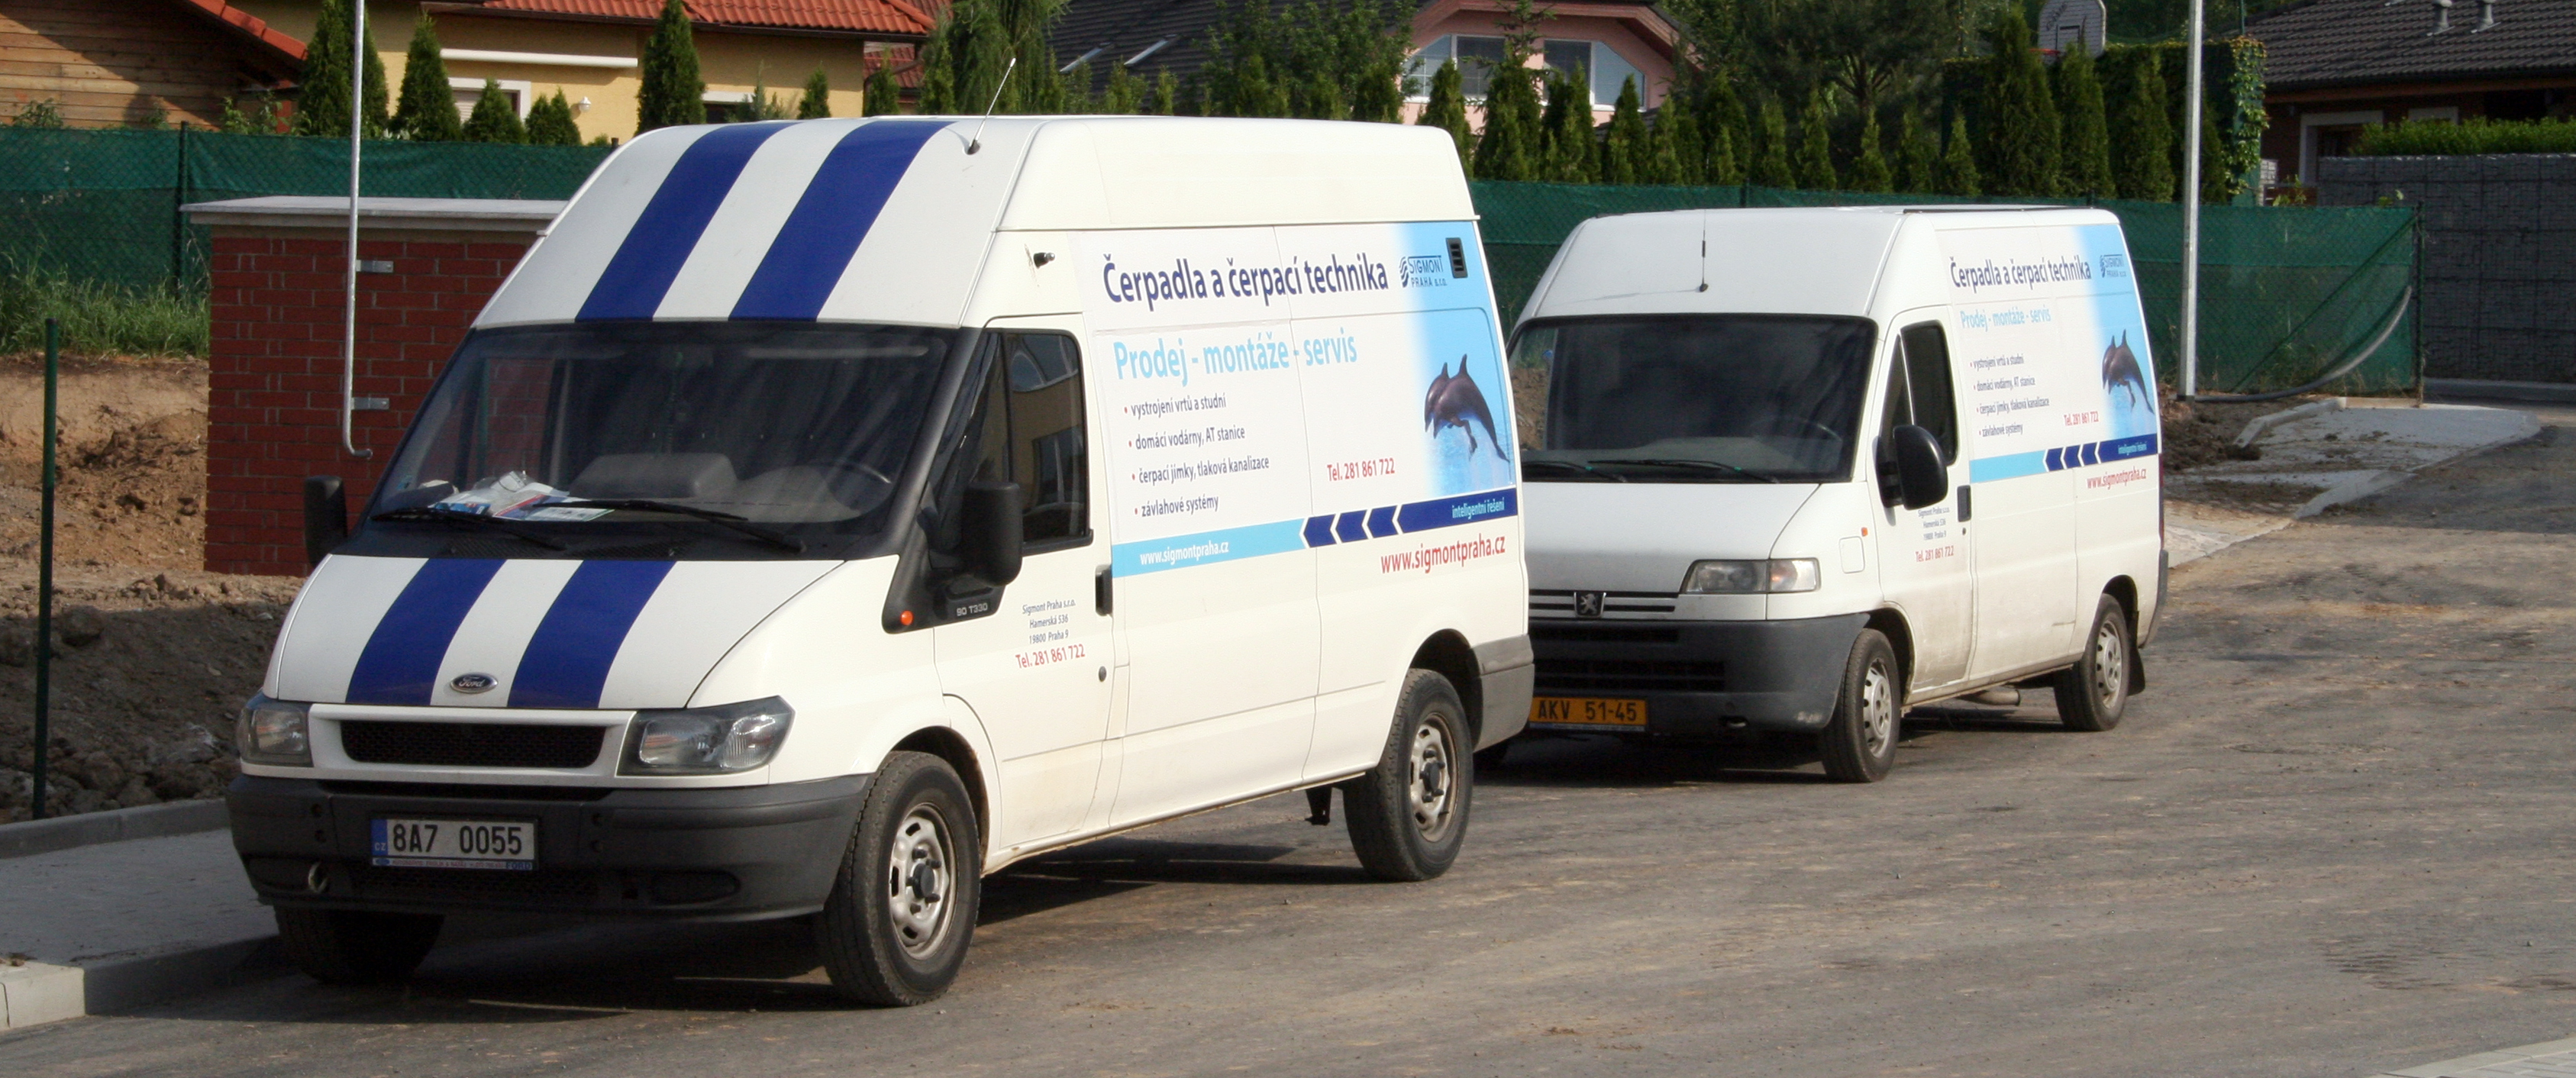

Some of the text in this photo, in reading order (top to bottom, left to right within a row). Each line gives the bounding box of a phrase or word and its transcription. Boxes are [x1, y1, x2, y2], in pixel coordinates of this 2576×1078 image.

[1407, 255, 1444, 274] SIGMONT
[1949, 254, 2092, 293] Čerpadla a čerpací technika
[1103, 252, 1389, 311] Čerpadla a čerpací technika
[1411, 276, 1433, 287] PRAHA
[1960, 309, 1988, 332] Prodej
[1992, 306, 2026, 326] montáže
[2029, 304, 2051, 323] servis
[1113, 337, 1188, 387] Prodej
[1202, 331, 1290, 374] montáže
[1303, 327, 1357, 366] servis
[1131, 392, 1227, 420] vystrojení vrtů a studní
[2064, 413, 2073, 426] Tel.
[2090, 411, 2100, 423] 722
[1135, 424, 1246, 450] domácí vodárny, AT stanice
[1138, 455, 1270, 486] čerpací jímky, tlaková kanalizace
[1327, 457, 1395, 482] Tel. 281 861 722
[2086, 466, 2147, 491] www.sigmontpraha.cz
[1141, 493, 1219, 517] závlahové systémy
[1452, 496, 1506, 520] inteligentní řešení
[1139, 539, 1229, 566] www.sigmontpraha.cz
[1380, 533, 1506, 573] www.sigmontpraha.cz
[1916, 550, 1925, 563] Tel.
[1944, 545, 1955, 557] 722
[968, 602, 988, 615] T330
[1022, 599, 1077, 616] Sigmont Praha s.r.o.
[1029, 614, 1069, 628] Hamerská 536
[1029, 629, 1069, 644] 19800 Praha 9
[1015, 644, 1086, 669] Tel. 281 861 722
[458, 676, 486, 687] Ford
[1538, 700, 1637, 721] AKV 51-45
[374, 842, 386, 852] CZ
[392, 824, 522, 854] 8A7 0055
[506, 861, 531, 870] FORD
